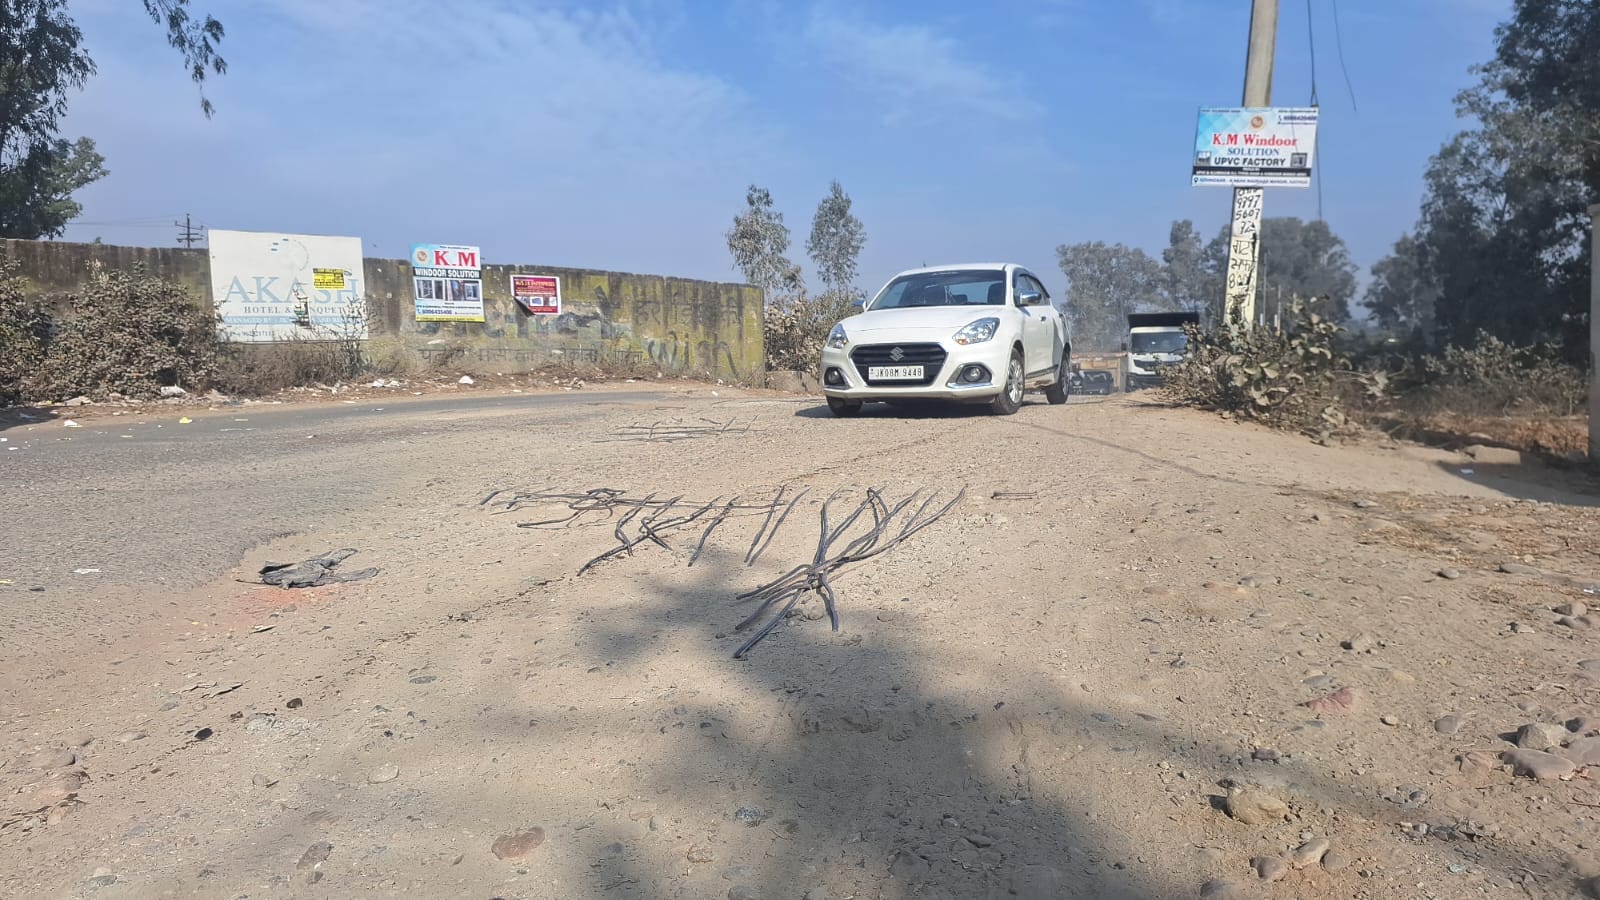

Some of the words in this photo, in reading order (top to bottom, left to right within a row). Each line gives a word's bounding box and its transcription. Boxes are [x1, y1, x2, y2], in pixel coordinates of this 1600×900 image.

[1212, 133, 1238, 146] K.M
[1243, 133, 1298, 147] Windoor
[1226, 147, 1280, 156] SOLUTION
[1214, 157, 1240, 166] UPVC
[1242, 158, 1286, 166] FACTORY
[415, 268, 447, 277] WINDOOR
[448, 269, 480, 279] SOLUTION
[225, 275, 360, 304] AKASH
[244, 304, 281, 314] HOTEL
[284, 305, 291, 314] &
[296, 305, 344, 315] NQUET
